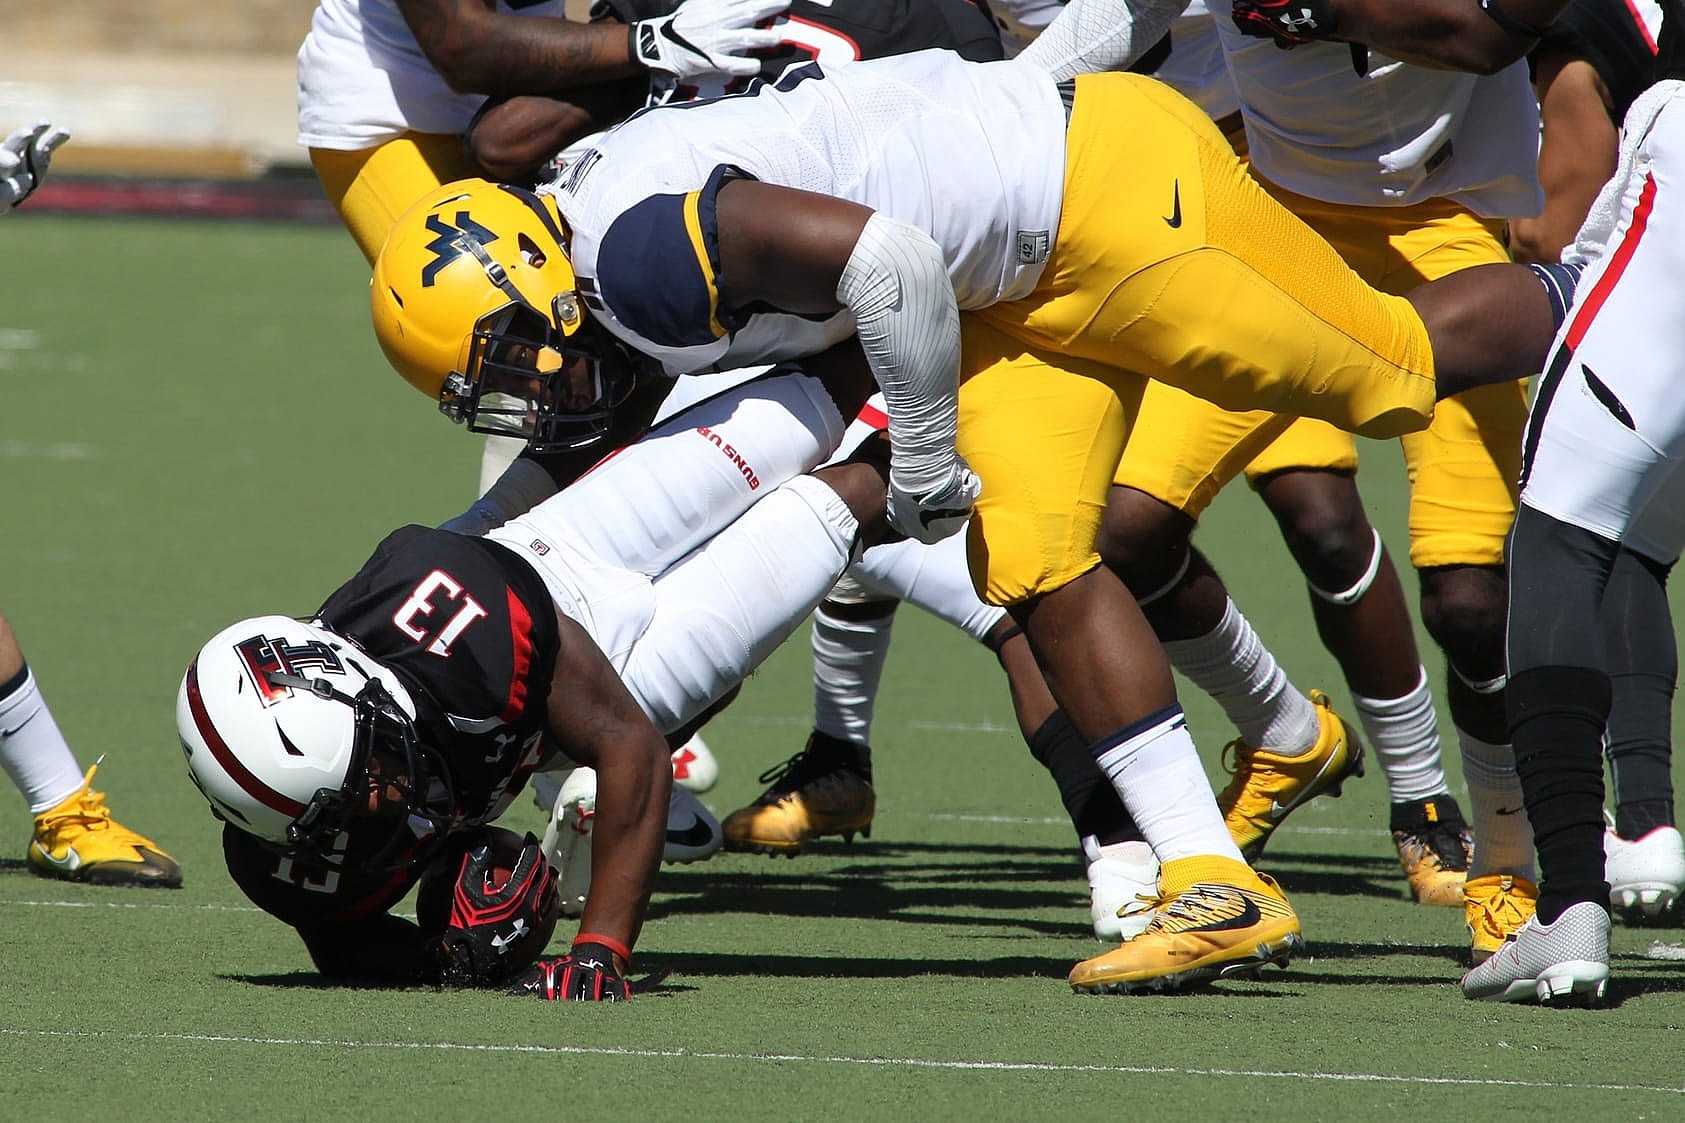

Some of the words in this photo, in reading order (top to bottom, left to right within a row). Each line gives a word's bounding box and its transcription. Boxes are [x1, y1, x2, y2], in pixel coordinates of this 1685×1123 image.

[1022, 243, 1033, 258] 42
[722, 443, 760, 491] GUNS
[391, 568, 489, 658] 13
